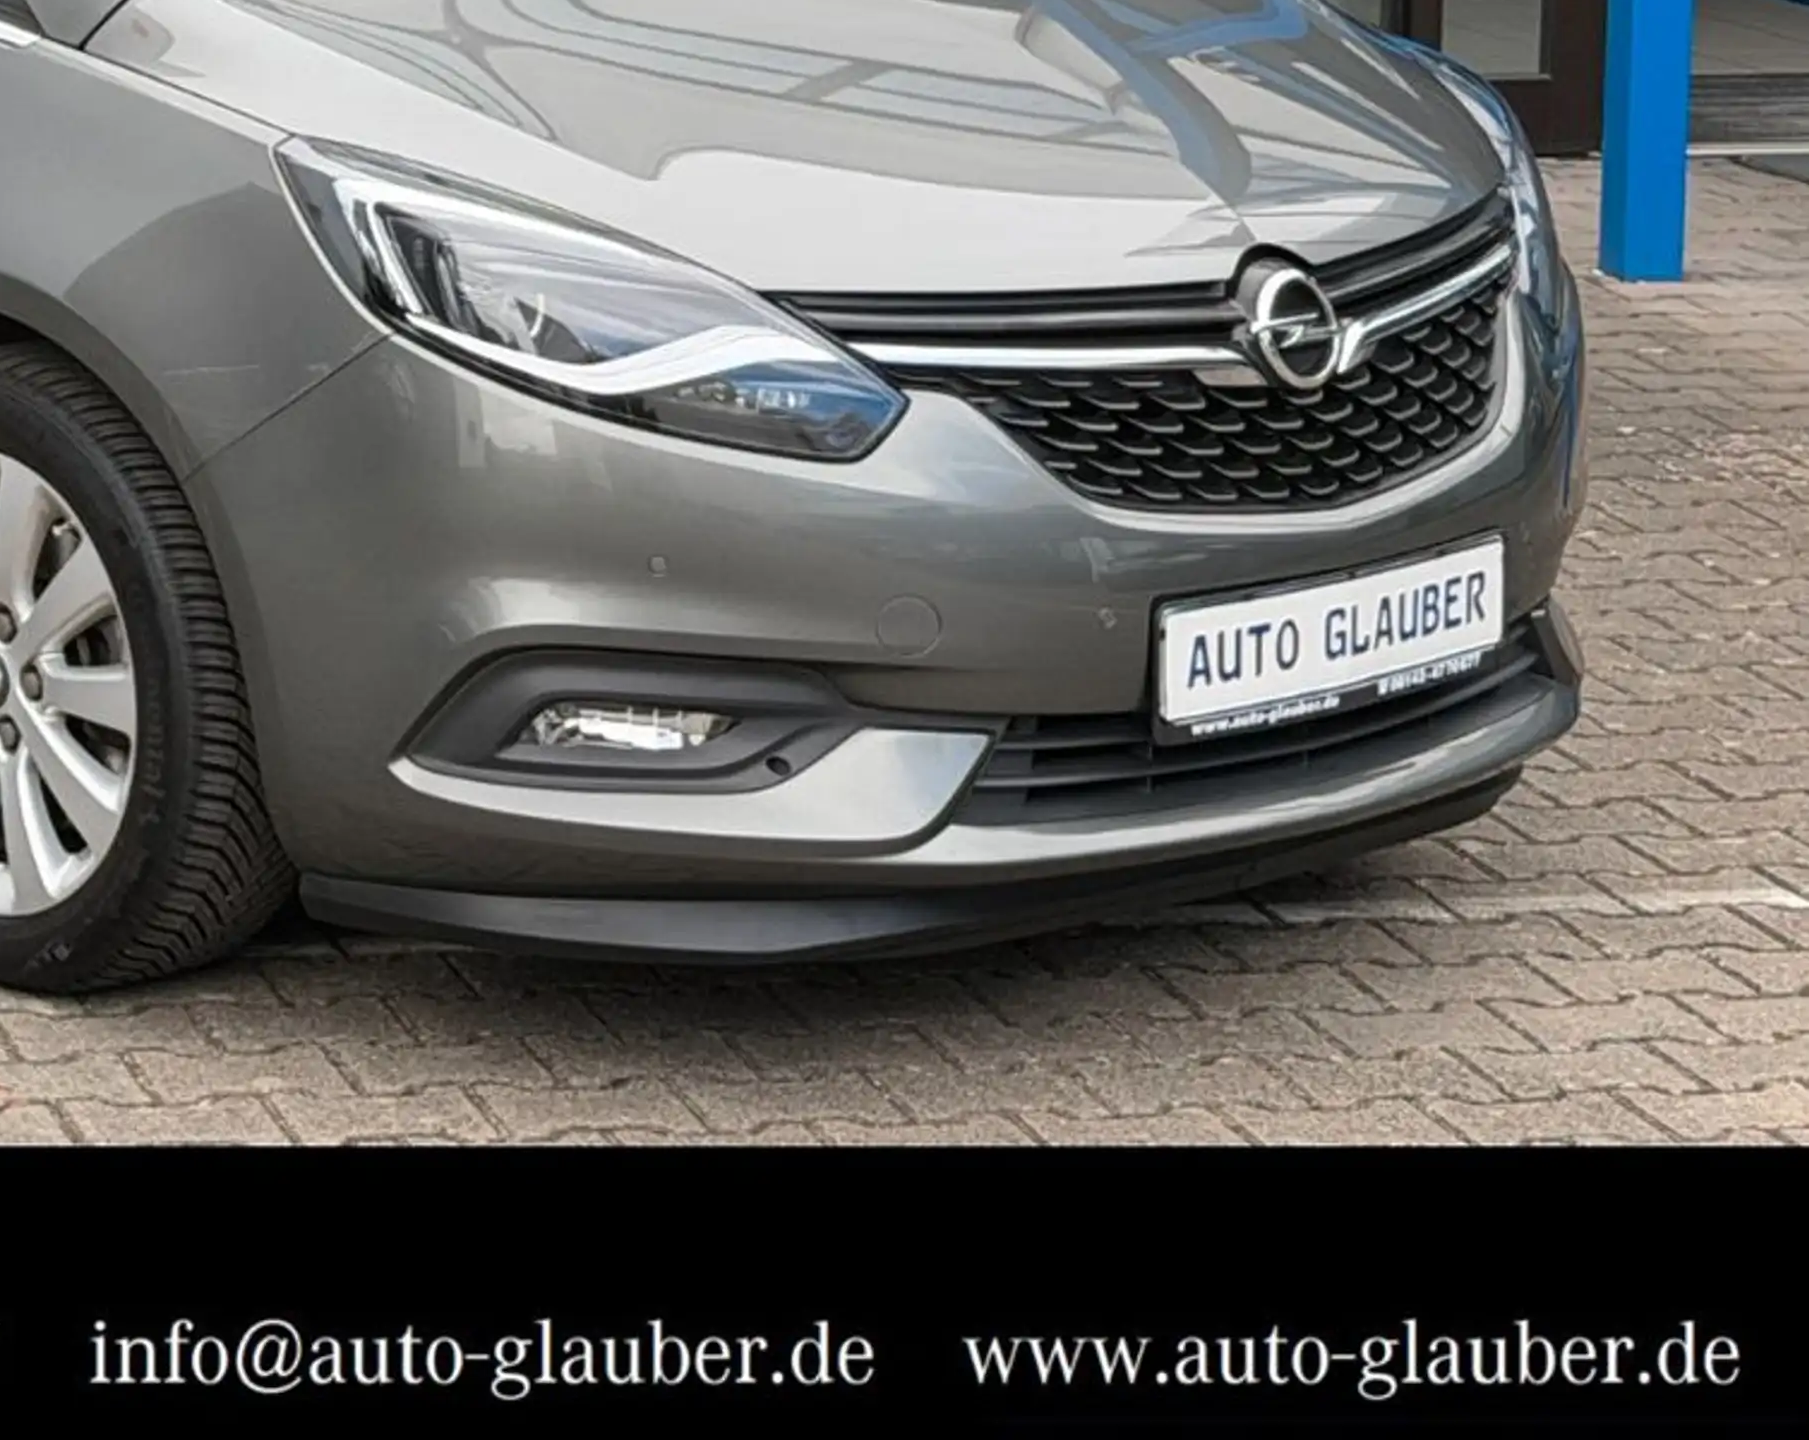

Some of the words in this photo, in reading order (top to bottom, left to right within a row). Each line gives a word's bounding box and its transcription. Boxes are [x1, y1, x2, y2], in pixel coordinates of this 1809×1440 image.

[1188, 621, 1300, 687] AUTO
[1325, 571, 1486, 659] GLAUBER
[1191, 693, 1340, 736] www.auto-glauber.de
